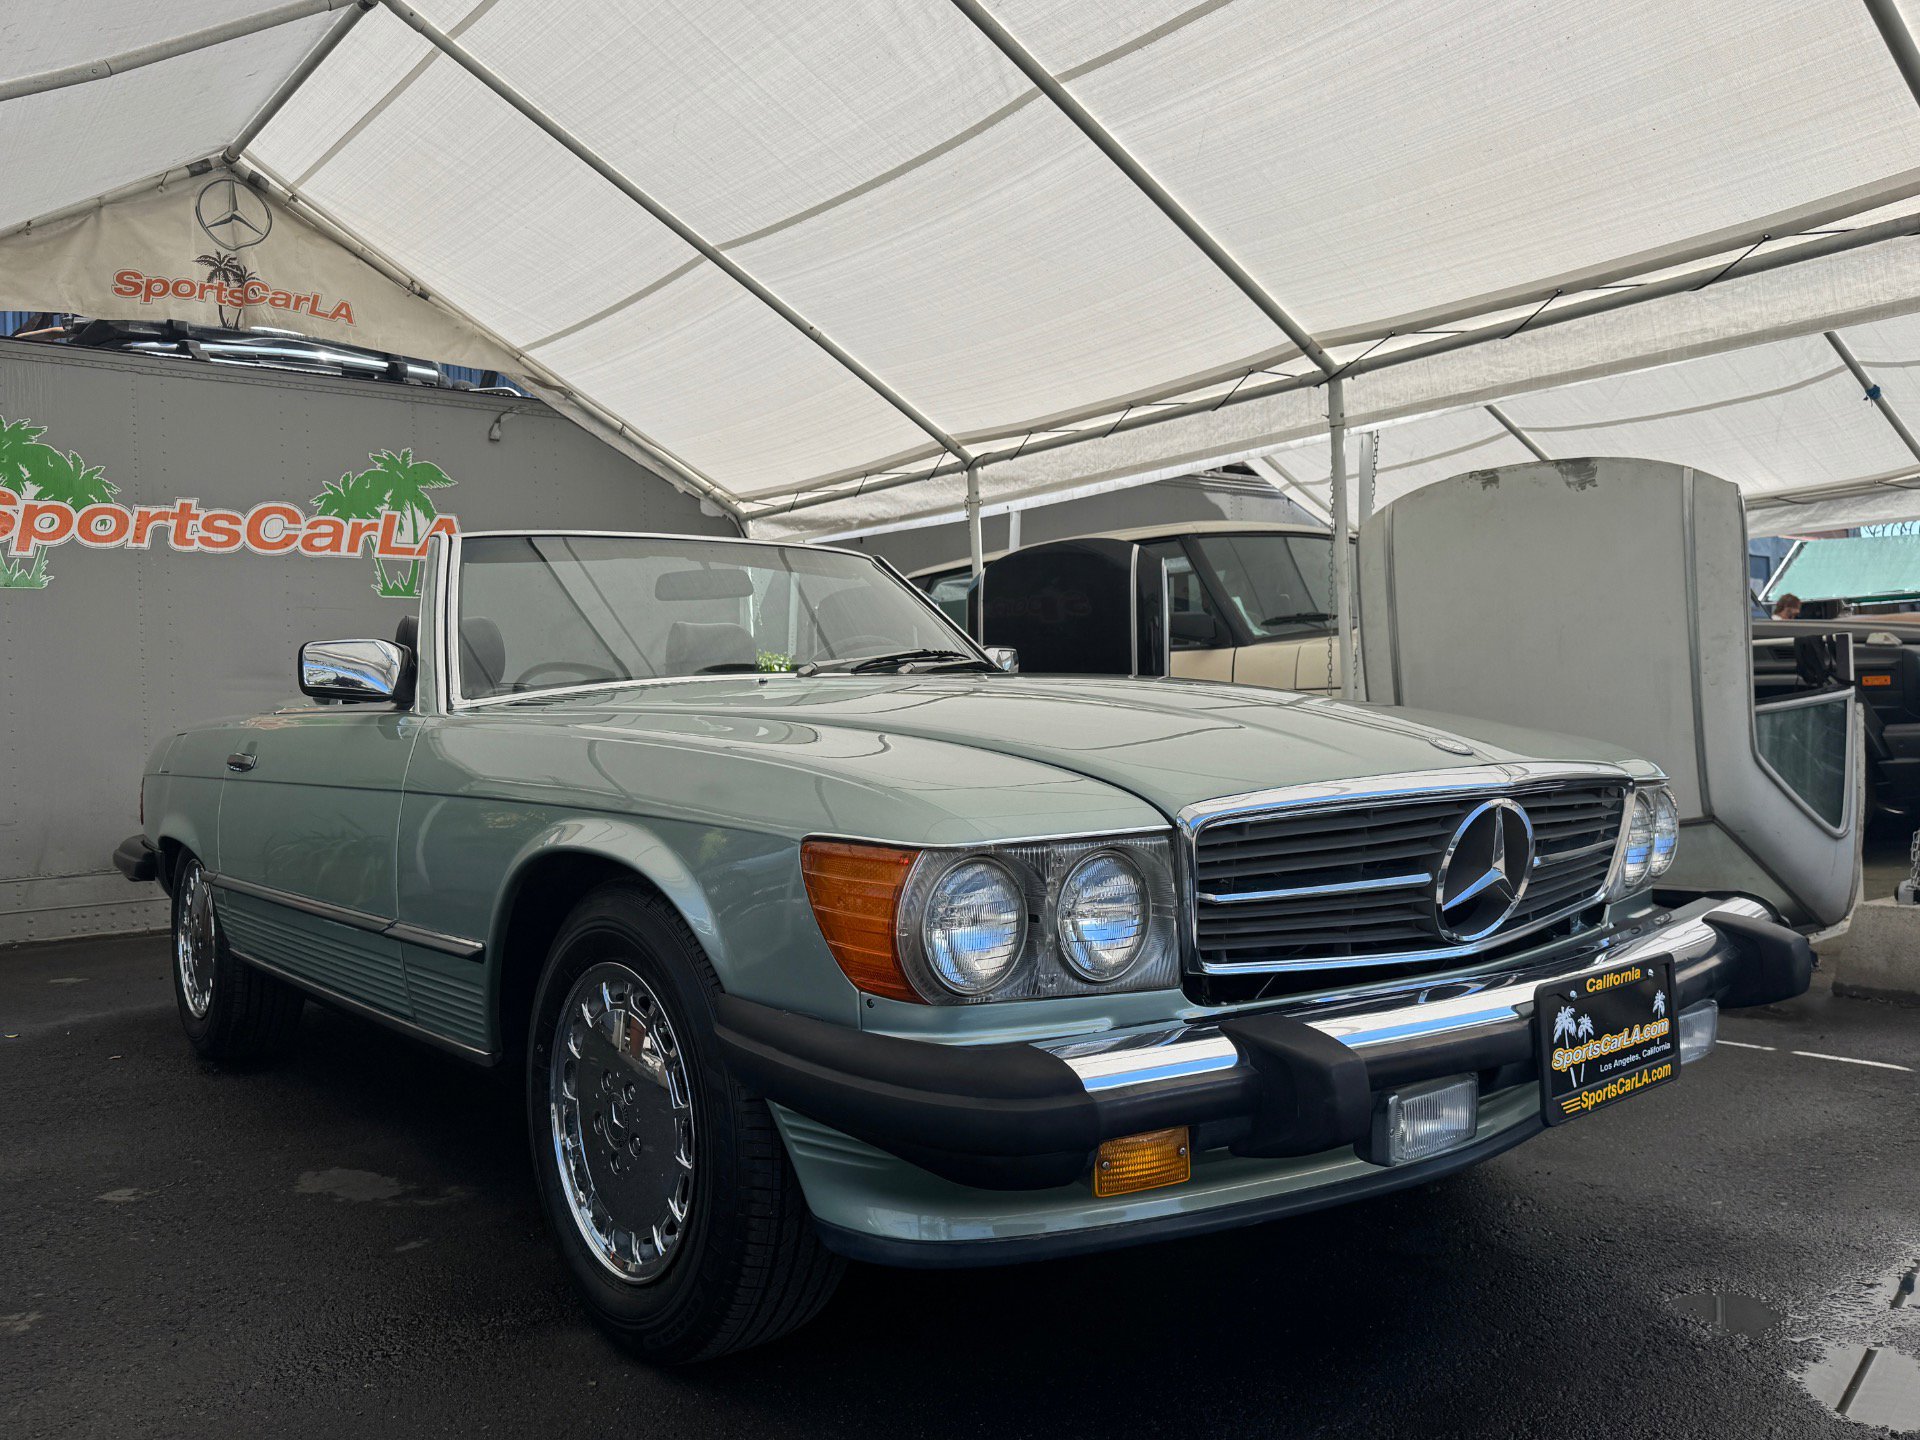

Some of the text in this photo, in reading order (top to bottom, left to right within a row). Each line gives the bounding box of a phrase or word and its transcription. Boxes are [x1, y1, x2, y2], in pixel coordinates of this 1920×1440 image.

[112, 269, 356, 327] SportsCarLA
[1586, 967, 1641, 993] California
[1552, 1018, 1671, 1072] SportsCarLA.com
[1600, 1042, 1671, 1073] Los Angeles, California
[1580, 1063, 1672, 1111] SportsCarLA.com
